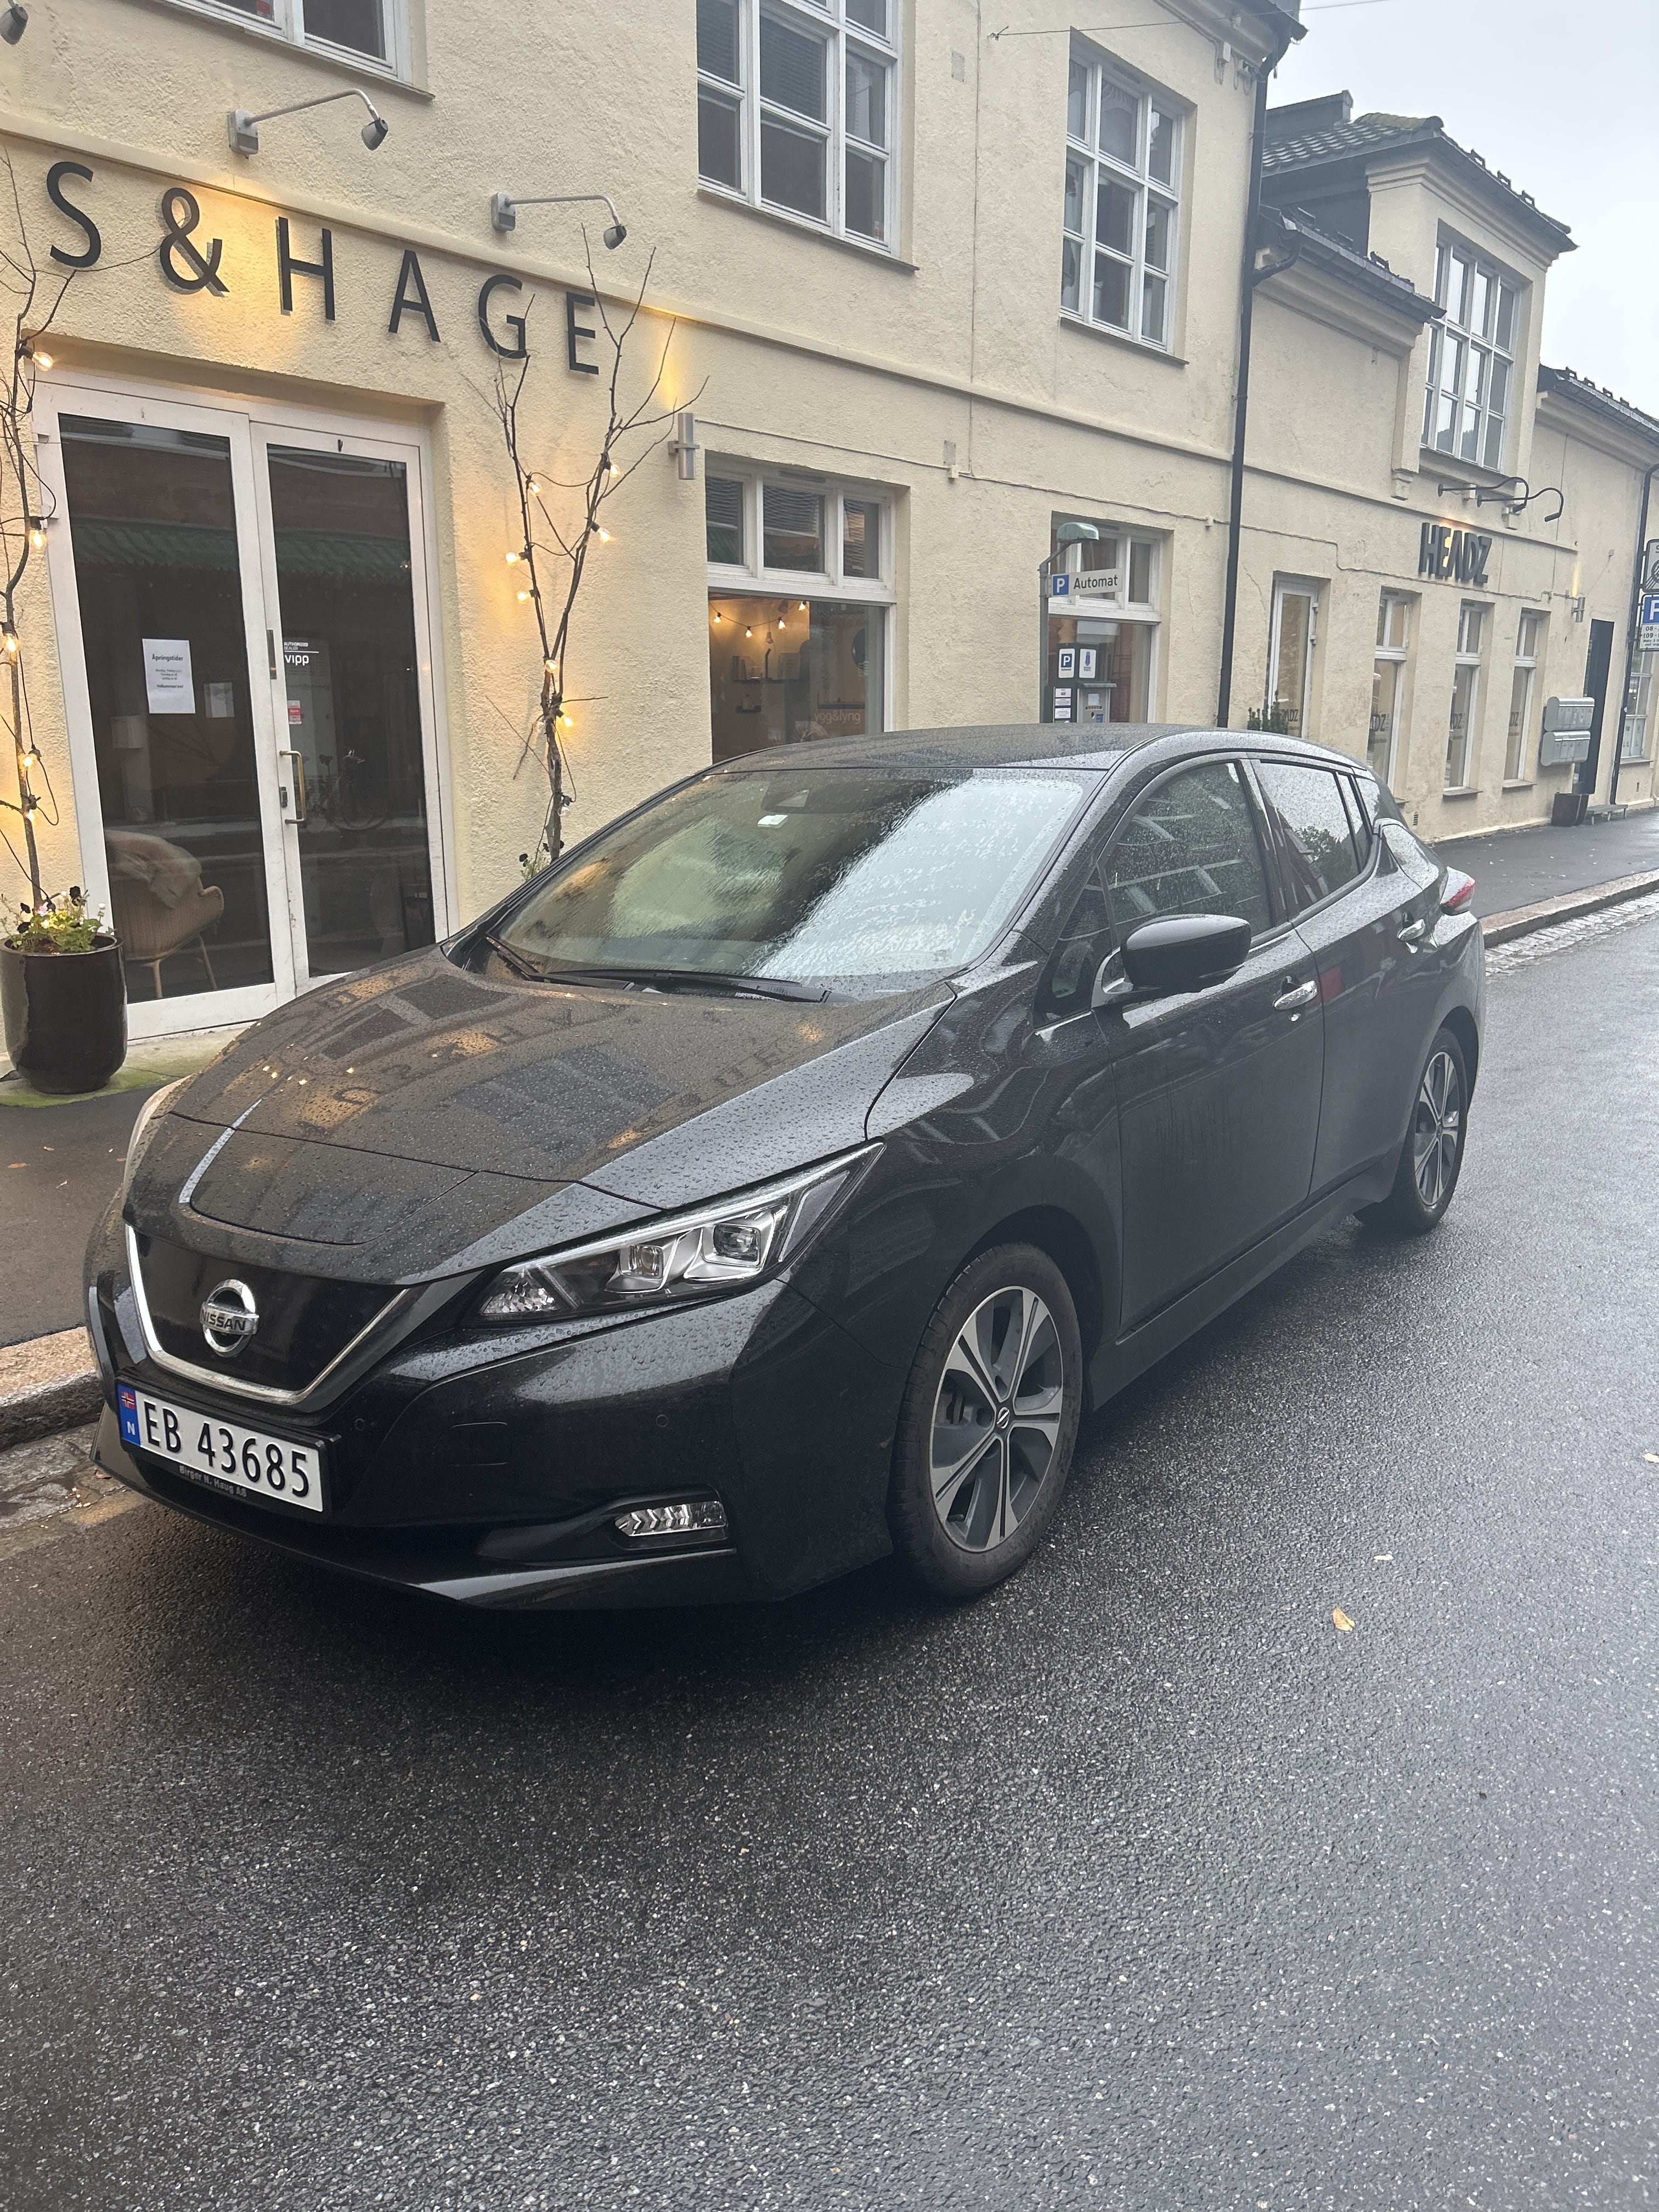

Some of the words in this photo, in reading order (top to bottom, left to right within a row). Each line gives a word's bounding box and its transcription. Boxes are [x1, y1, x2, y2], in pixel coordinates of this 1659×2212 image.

[46, 160, 102, 268] S
[159, 187, 229, 294] &
[278, 217, 600, 375] HAGE
[1419, 522, 1493, 584] HEADZ
[1073, 574, 1118, 590] Automat
[152, 654, 183, 662] Åpningstider
[201, 1309, 246, 1331] NISSAN
[127, 1421, 136, 1435] N
[144, 1401, 182, 1453] EB
[198, 1423, 309, 1497] 43685
[179, 1465, 202, 1481] Birger
[213, 1478, 234, 1495] Haug
